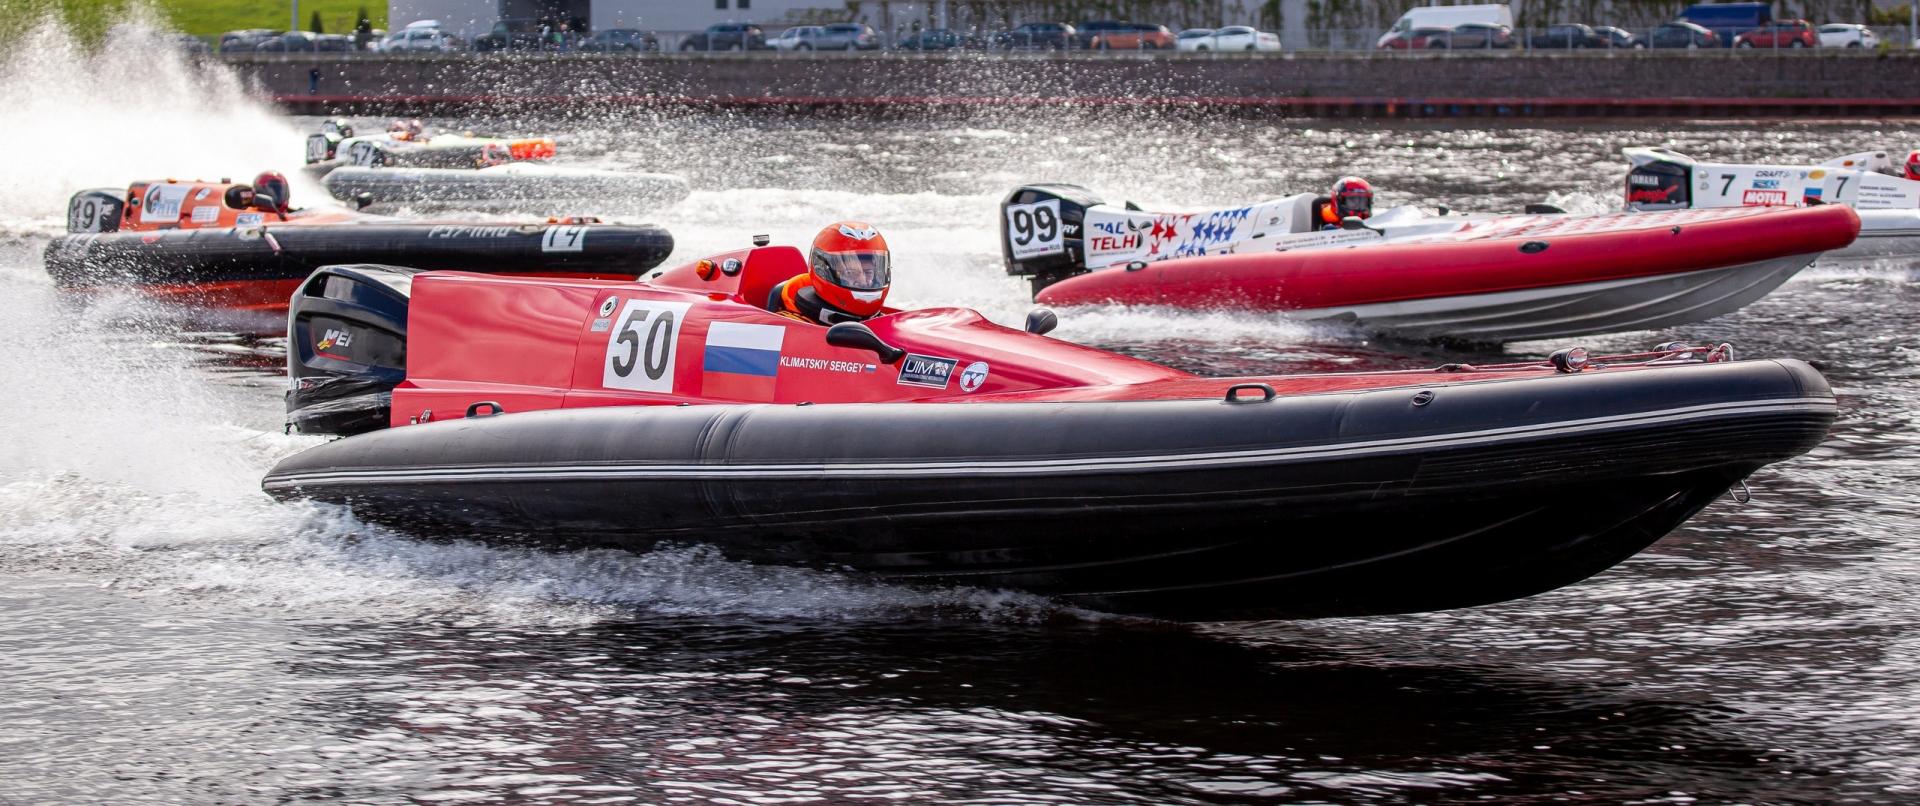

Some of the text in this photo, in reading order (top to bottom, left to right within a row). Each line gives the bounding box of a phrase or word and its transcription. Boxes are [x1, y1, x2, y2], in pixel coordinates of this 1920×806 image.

[1631, 175, 1659, 186] YAMAHA
[1721, 174, 1736, 196] 7
[1837, 176, 1850, 198] 7
[1745, 192, 1784, 205] MOTUL
[1013, 206, 1057, 246] 99
[612, 309, 675, 381] 50
[780, 356, 865, 373] KLIMATSKIY SERGEY
[905, 359, 935, 375] UIM
